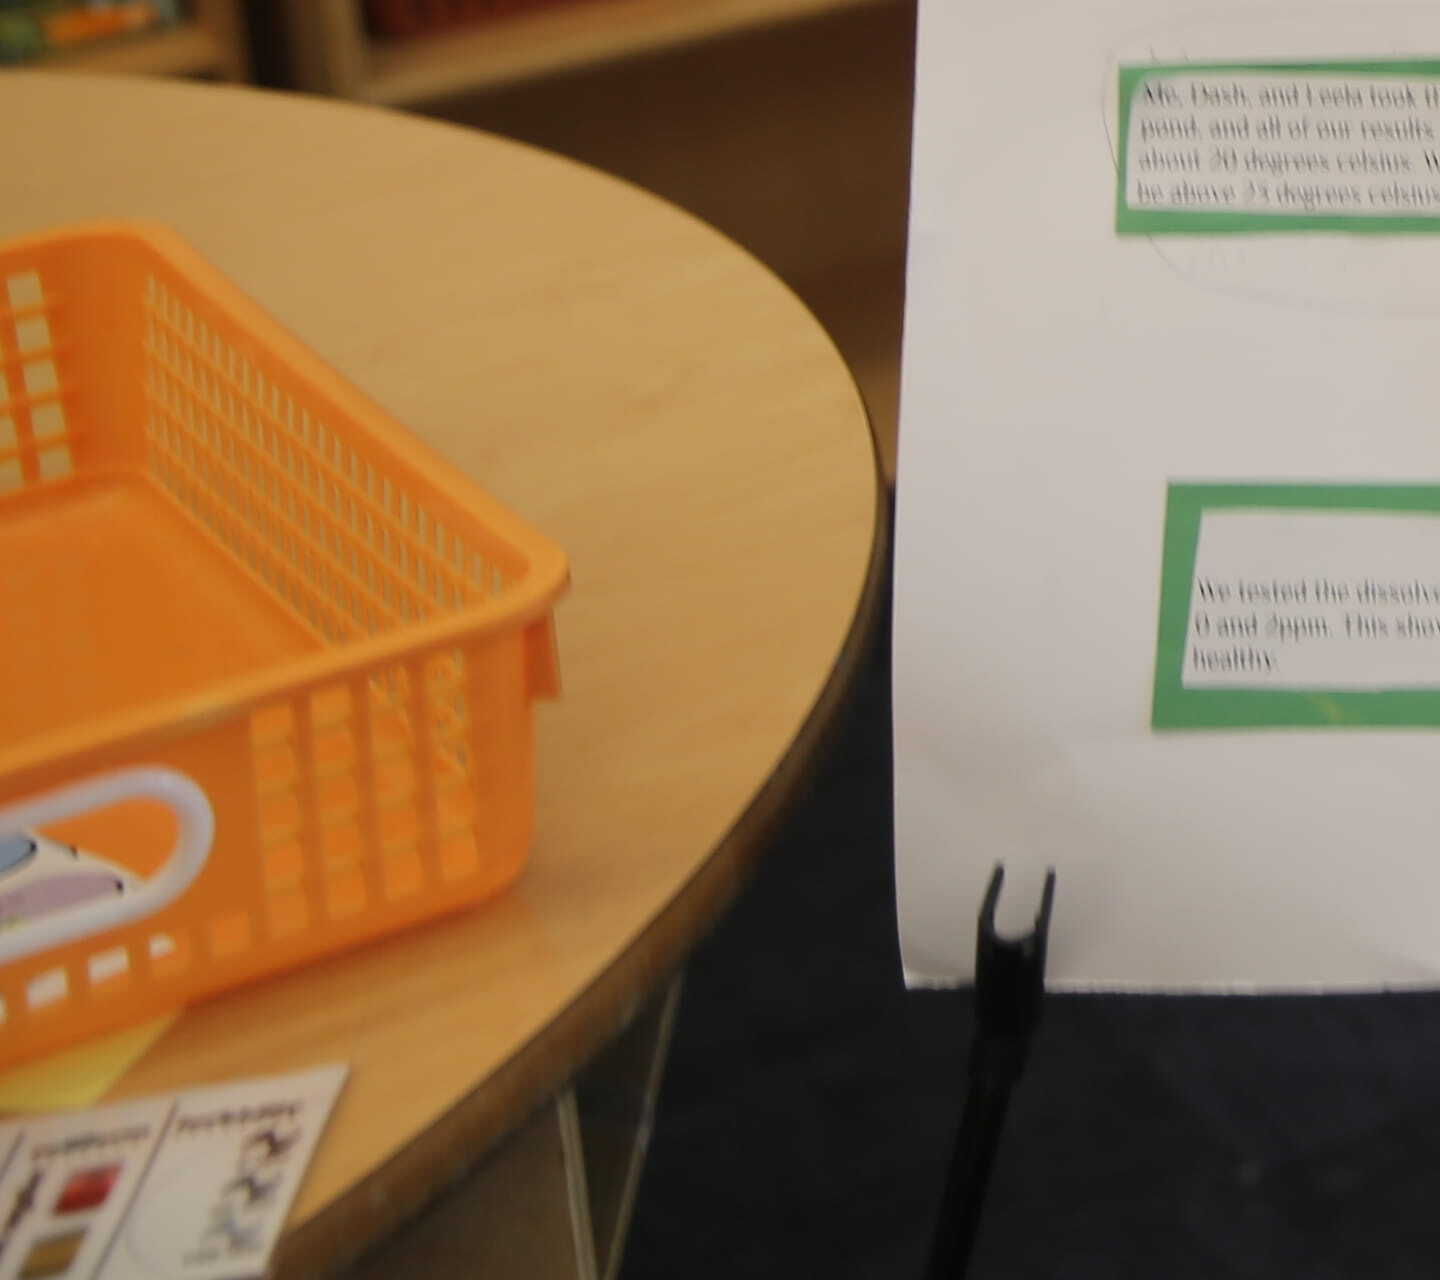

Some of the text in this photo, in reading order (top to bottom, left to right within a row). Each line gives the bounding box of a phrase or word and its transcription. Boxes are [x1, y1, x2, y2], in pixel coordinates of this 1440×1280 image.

[1258, 83, 1299, 107] and
[1370, 83, 1416, 109] took
[1209, 115, 1250, 140] and
[1256, 114, 1281, 139] all
[1287, 115, 1308, 141] of
[1316, 119, 1350, 141] our
[1360, 116, 1433, 142] results
[1138, 148, 1201, 172] about
[1243, 147, 1330, 176] degrees
[1137, 179, 1164, 204] be
[1170, 180, 1236, 205] above
[1276, 180, 1362, 213] degrees
[1196, 578, 1231, 603] We
[1239, 579, 1307, 603] tested
[1315, 579, 1351, 602] the
[1218, 611, 1258, 637] and
[1345, 611, 1389, 639] This
